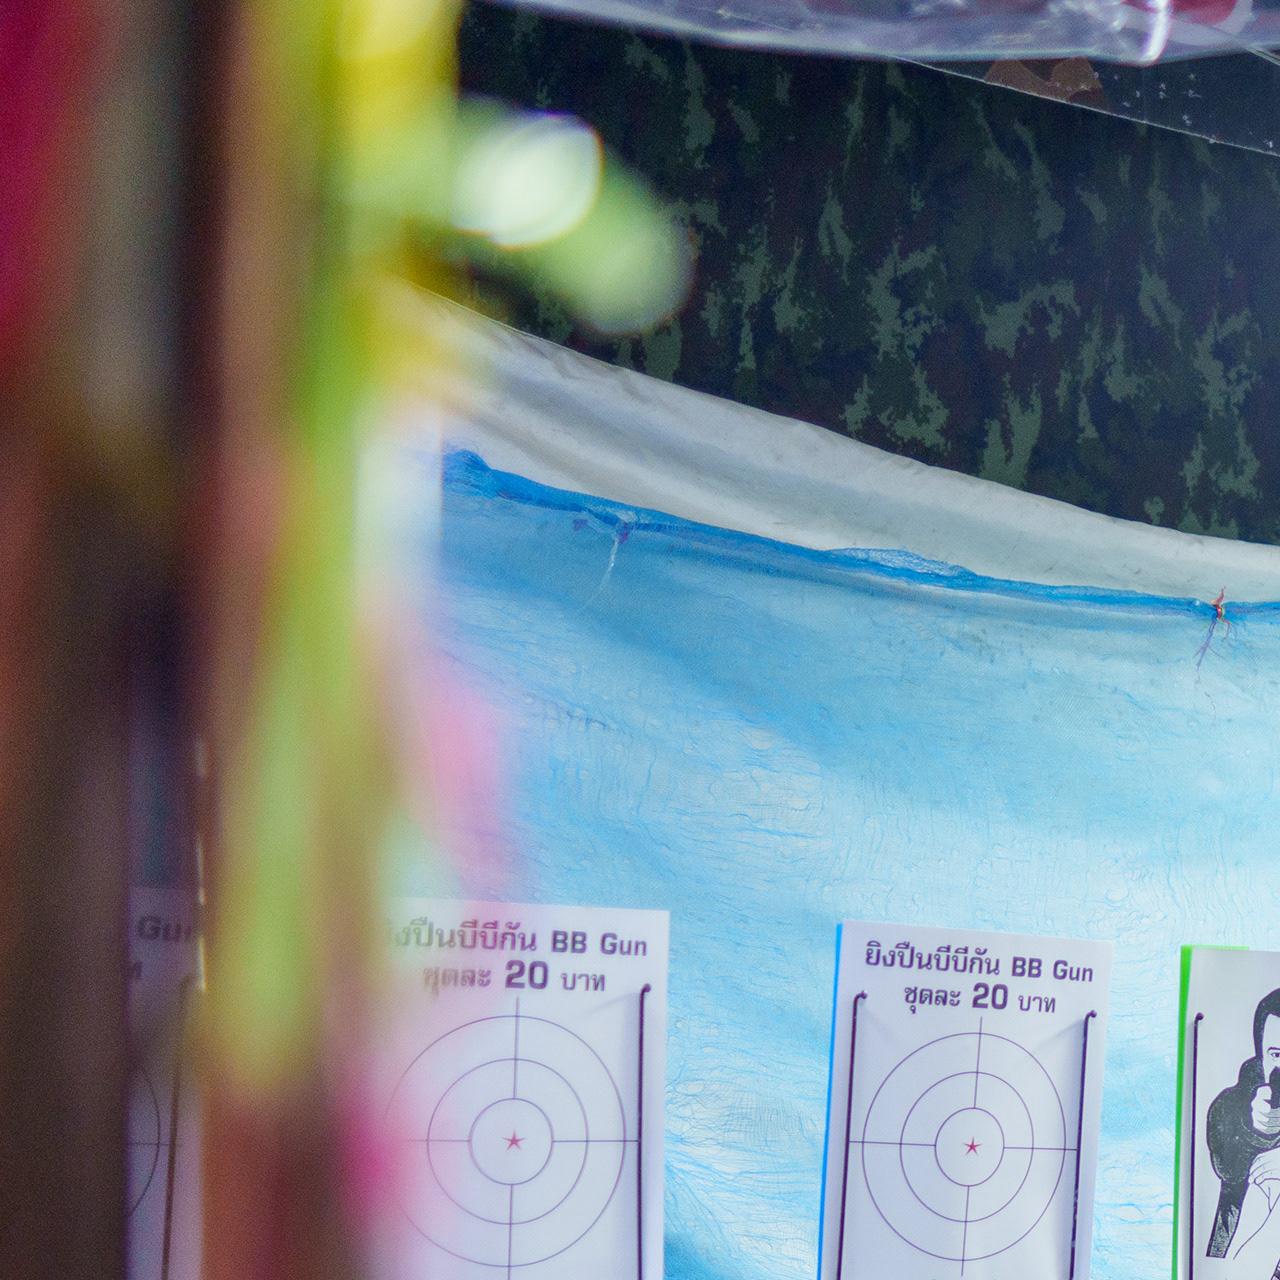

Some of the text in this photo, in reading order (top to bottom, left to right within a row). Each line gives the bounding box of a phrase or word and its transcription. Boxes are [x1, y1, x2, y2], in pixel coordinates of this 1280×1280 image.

[551, 929, 588, 954] BB
[599, 932, 648, 957] Gun
[864, 939, 1094, 982] ยิงปืนบีบีกัน BB Gun
[422, 959, 607, 1000] ชุดละ 20 บาท
[903, 981, 1056, 1014] ชุดละ 20 บาท
